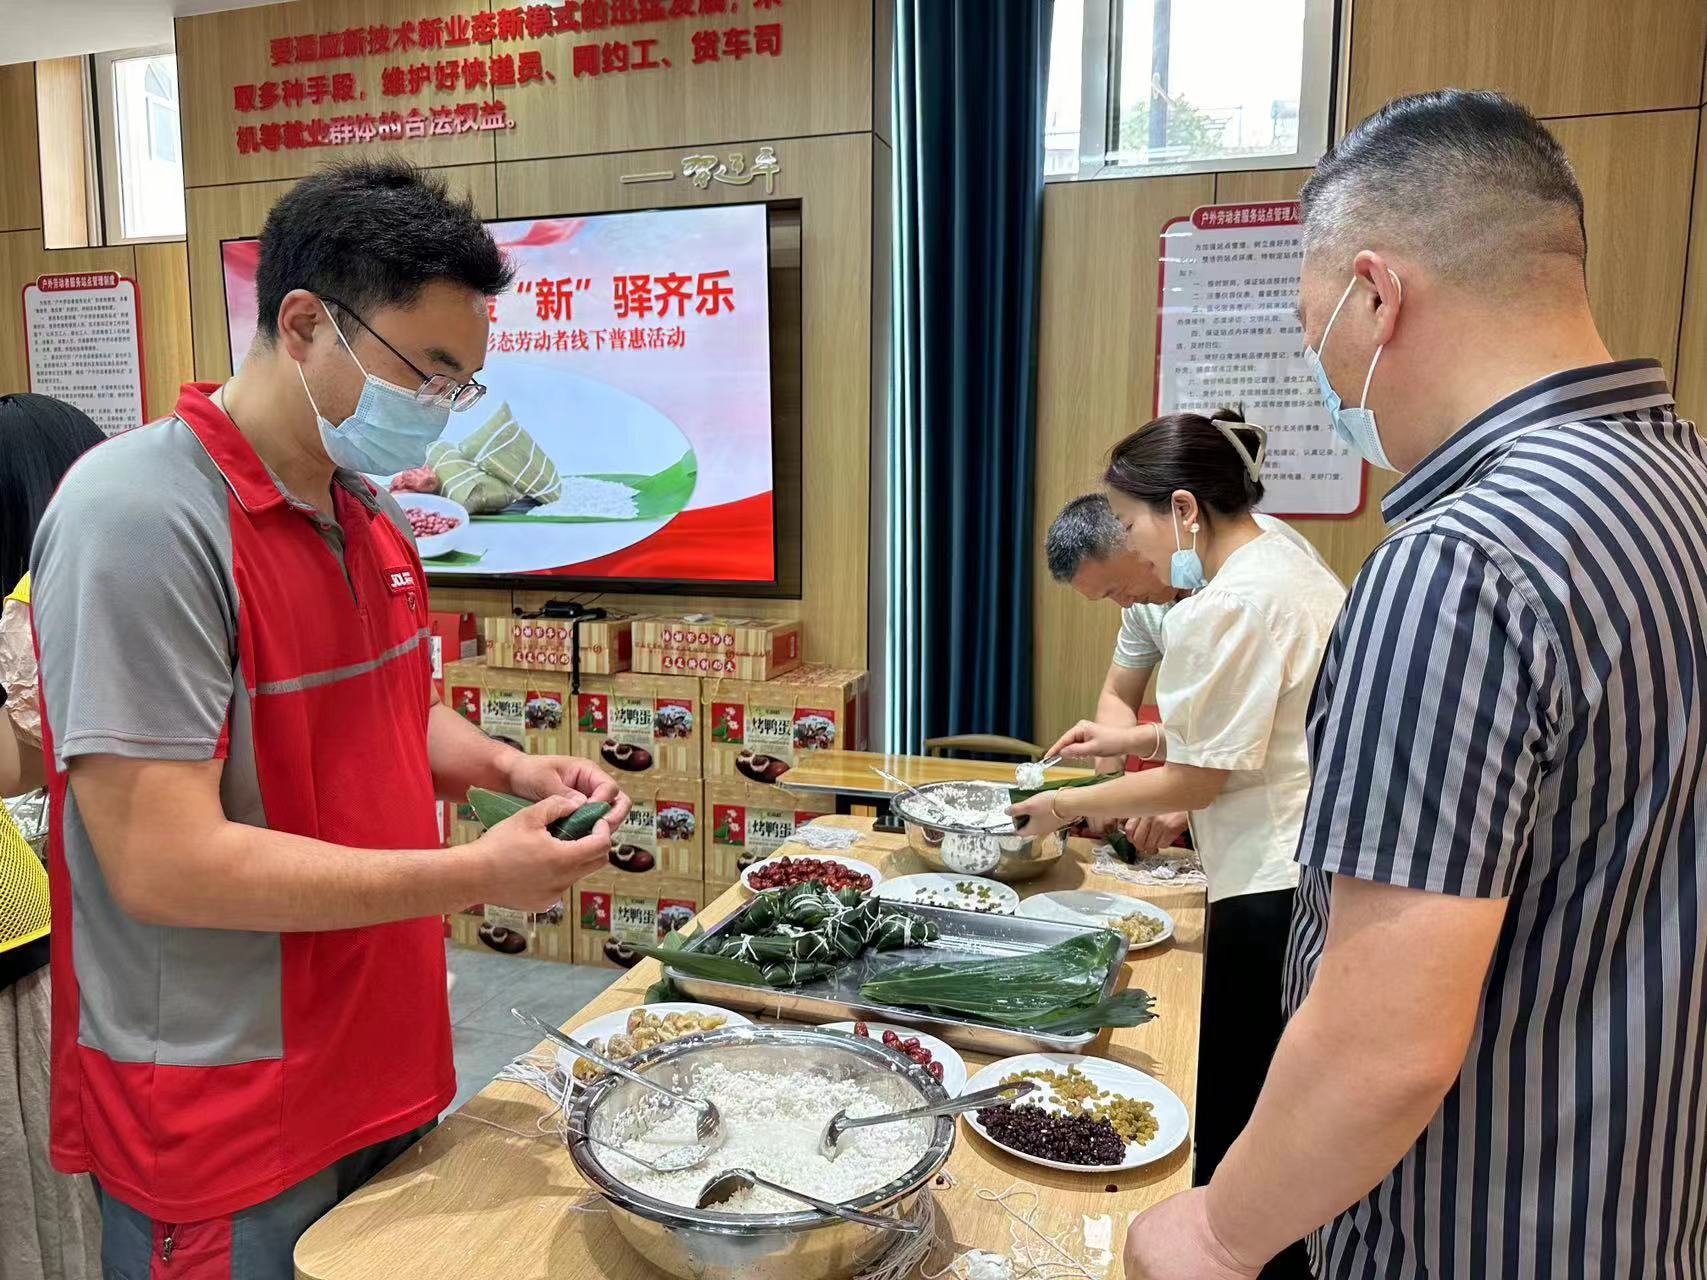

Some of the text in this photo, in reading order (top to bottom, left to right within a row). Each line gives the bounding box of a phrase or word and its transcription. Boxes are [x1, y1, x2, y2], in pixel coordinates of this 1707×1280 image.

[236, 100, 516, 154] 机等就业群体的合法权益。
[1200, 207, 1299, 225] 户外劳动者服务站点管理人
[625, 810, 655, 826] 鸭蛋
